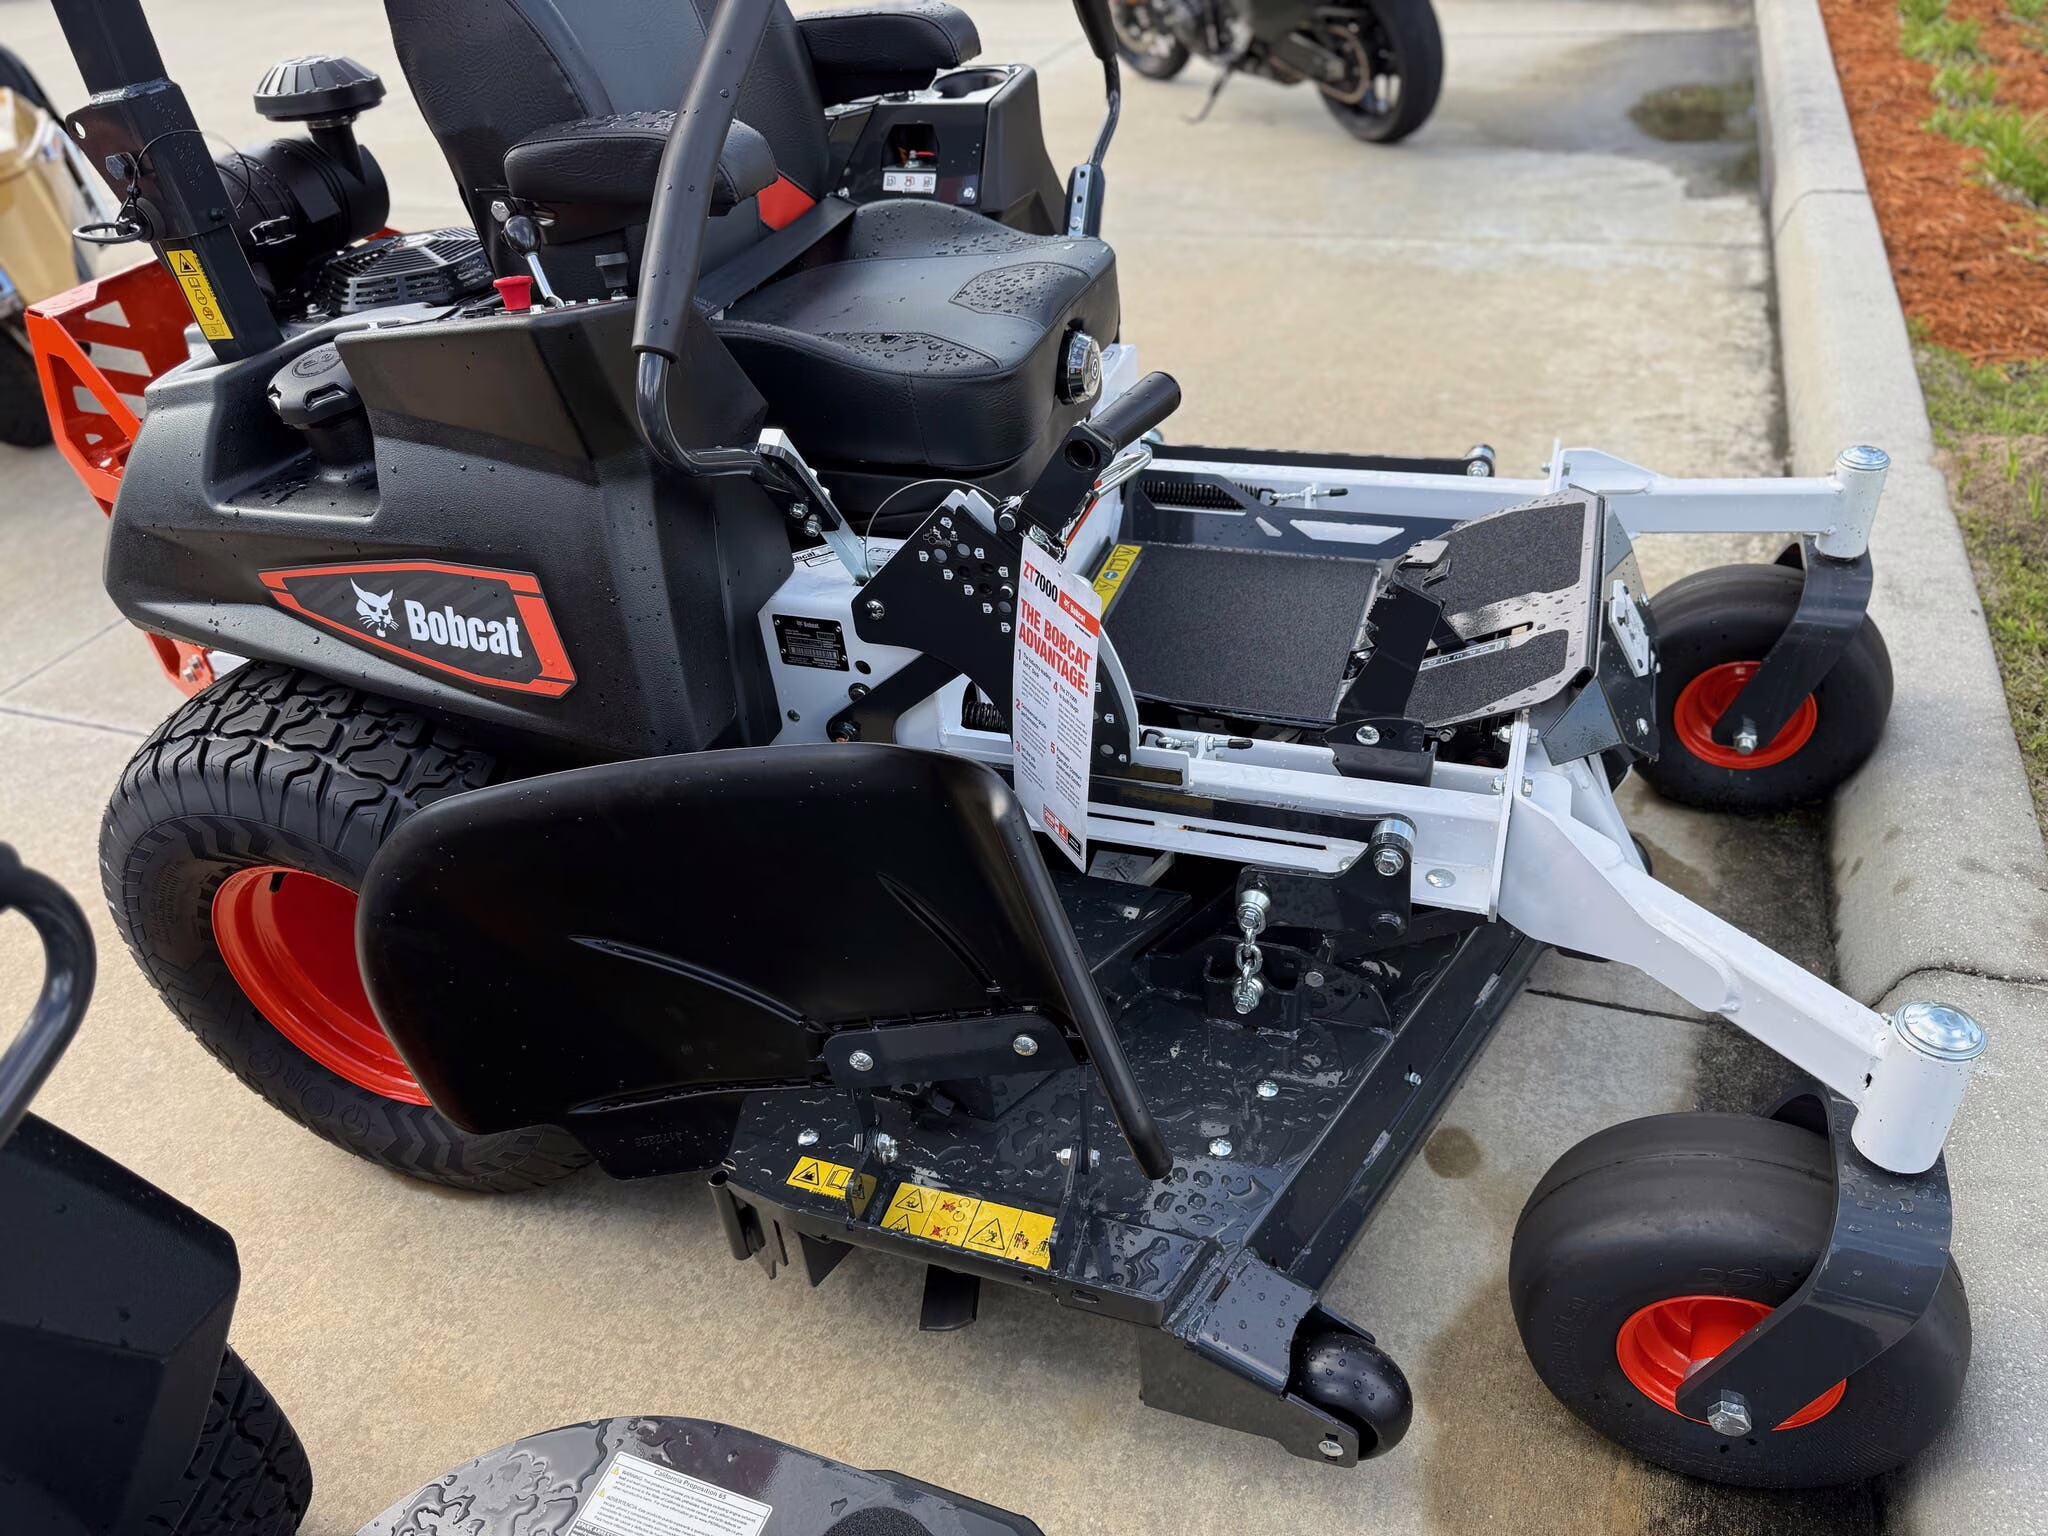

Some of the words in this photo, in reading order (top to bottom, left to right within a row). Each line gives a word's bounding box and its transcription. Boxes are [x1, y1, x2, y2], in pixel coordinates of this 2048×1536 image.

[1023, 560, 1058, 603] ZT7000
[404, 600, 522, 658] Bobcat
[1021, 598, 1041, 632] THE
[1044, 619, 1090, 673] BOBCAT
[1070, 603, 1086, 625] Bobcat
[1019, 622, 1088, 698] ADVANTAGE:
[653, 1469, 683, 1483] California
[682, 1480, 718, 1497] Proposition
